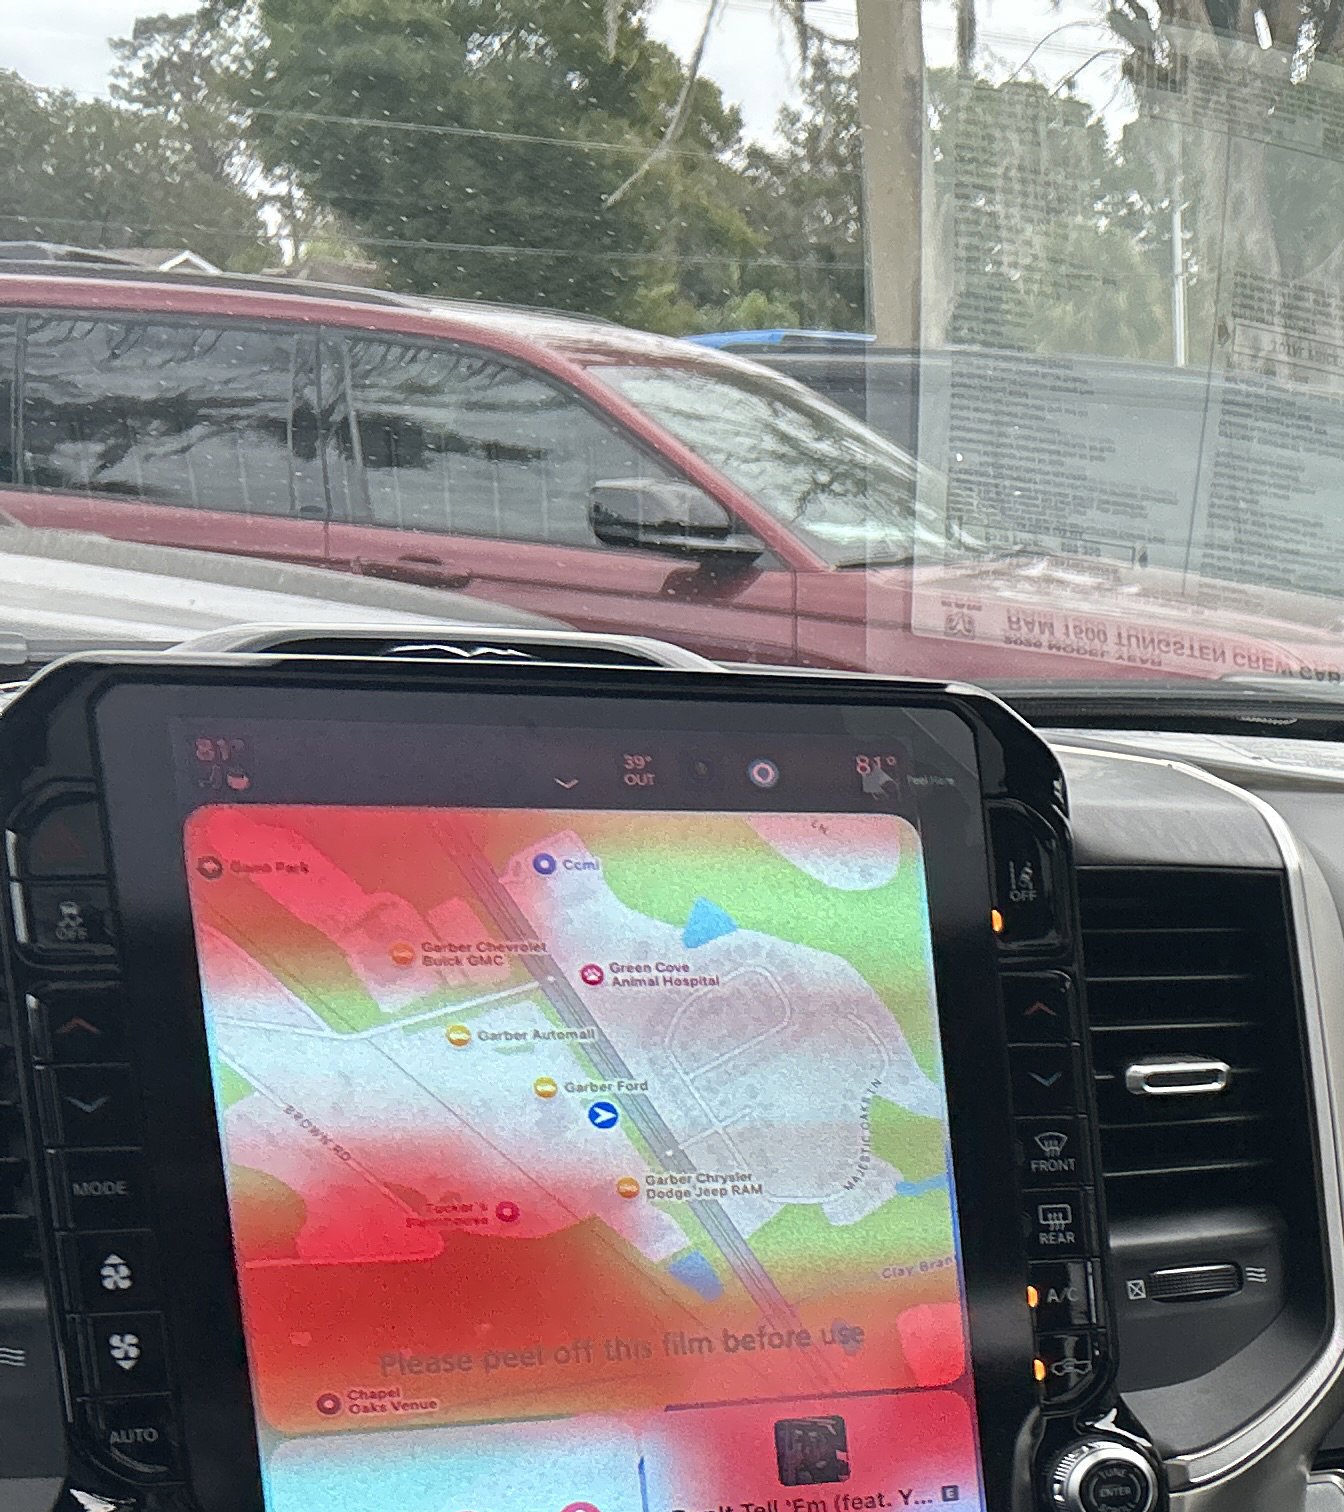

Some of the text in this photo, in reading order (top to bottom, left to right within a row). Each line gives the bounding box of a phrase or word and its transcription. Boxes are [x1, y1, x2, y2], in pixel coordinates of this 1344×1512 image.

[624, 774, 656, 786] OUT
[1010, 890, 1038, 902] OFF
[55, 927, 89, 941] OFF
[421, 941, 547, 953] Garber Chevrolet
[422, 954, 504, 967] Buick GMC
[609, 962, 690, 974] Green Cove
[612, 974, 720, 988] Animal Hospital
[477, 1029, 595, 1042] Garber Automall
[563, 1080, 648, 1093] Garber Ford
[1031, 1159, 1076, 1173] FRONT
[645, 1172, 753, 1186] Garber Chrysler
[72, 1181, 129, 1198] MODE
[645, 1184, 763, 1201] Dodge Jeep RAM
[1038, 1231, 1076, 1246] REAR
[881, 1266, 915, 1279] Clay
[1046, 1286, 1078, 1303] A/C
[379, 1325, 866, 1378] Please peel off this film before use
[347, 1388, 401, 1402] Chapel
[390, 1399, 438, 1411] Venue
[110, 1427, 160, 1445] AUTO
[1100, 1486, 1132, 1498] ENTER
